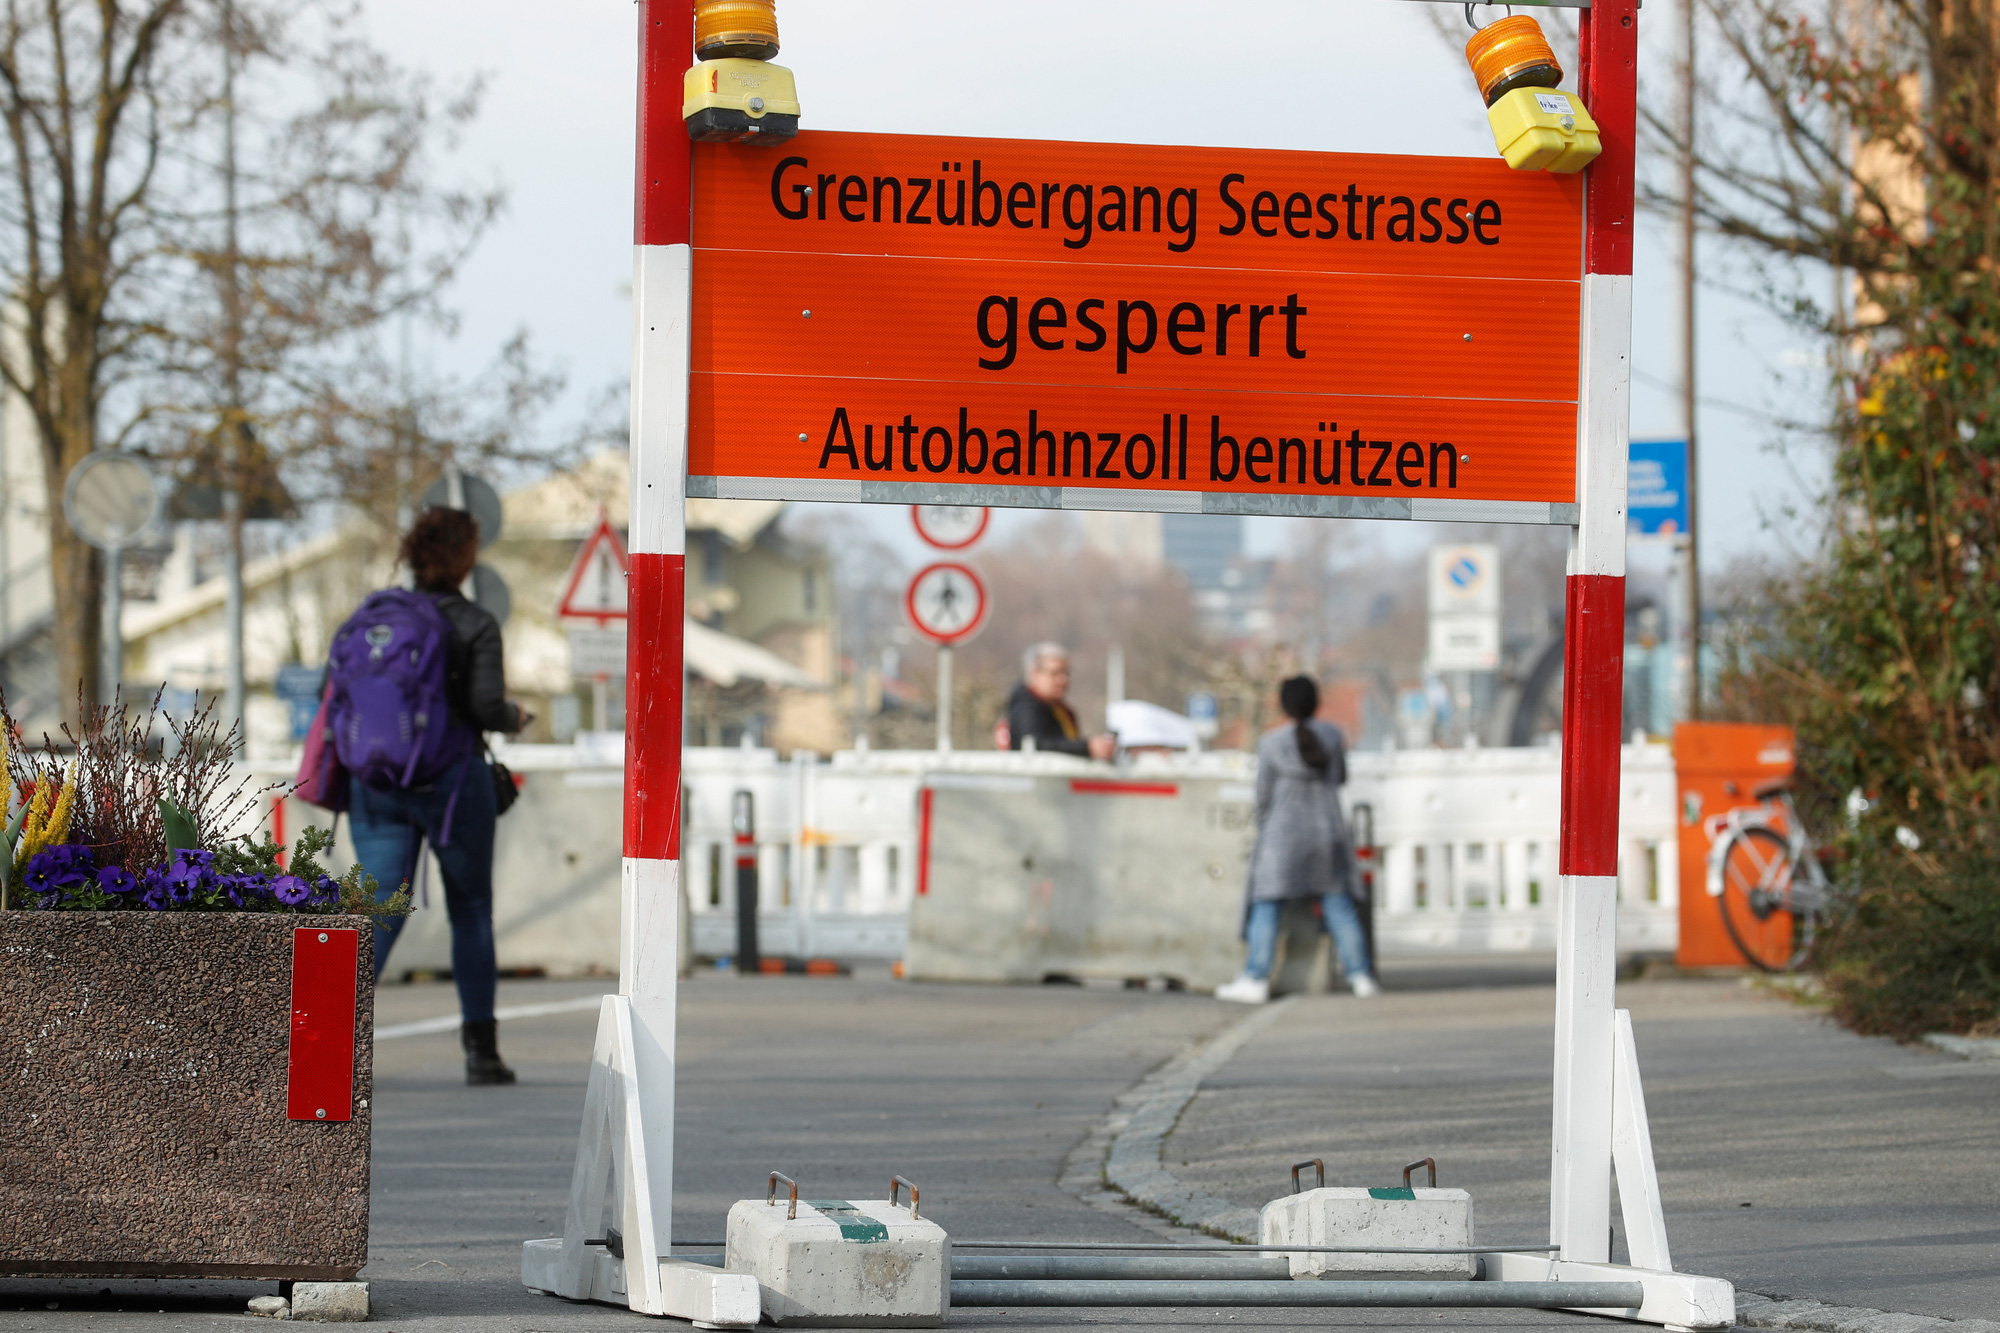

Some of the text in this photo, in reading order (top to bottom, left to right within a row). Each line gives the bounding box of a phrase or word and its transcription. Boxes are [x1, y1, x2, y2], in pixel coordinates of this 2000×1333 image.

[771, 156, 1503, 253] Grenzübergang Seestrasse
[977, 294, 1307, 375] gesperrt
[819, 406, 1458, 488] Autobahnzoll benützen
